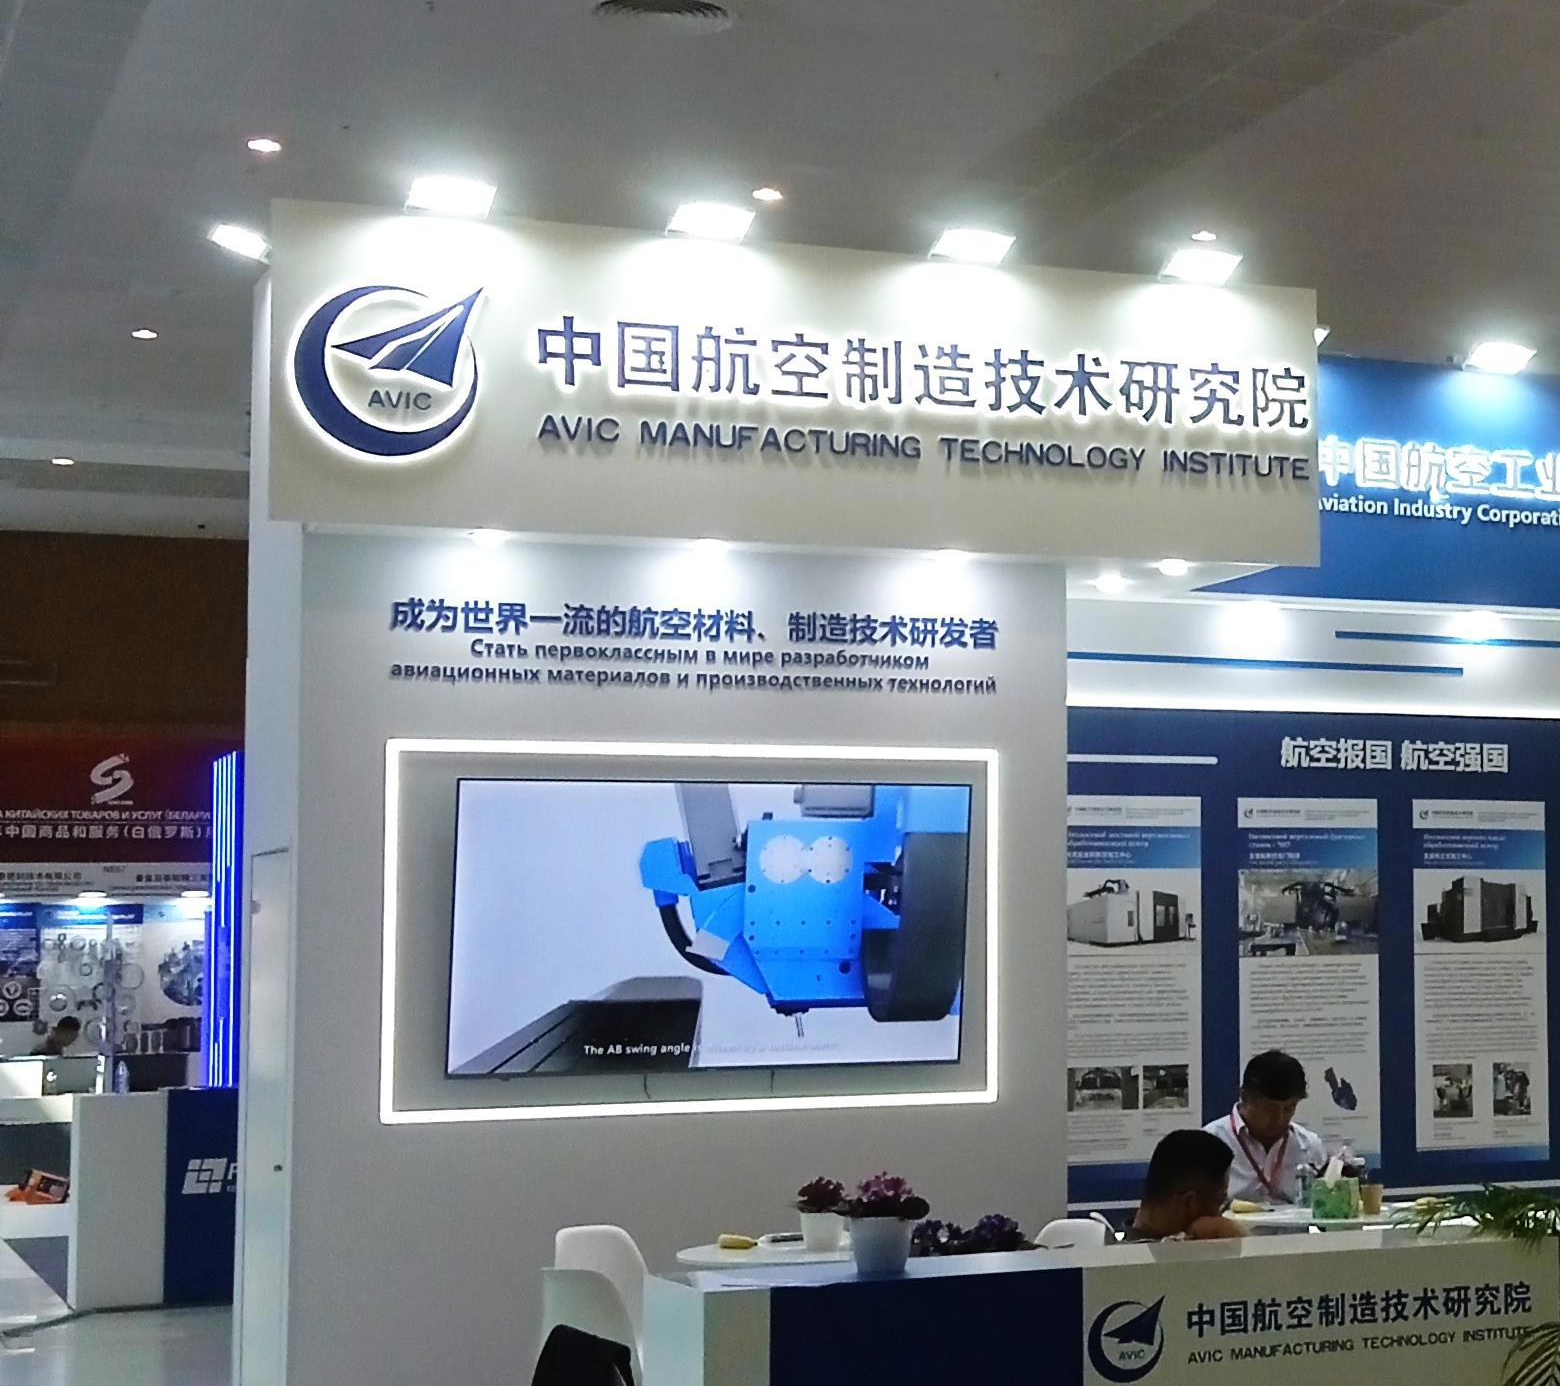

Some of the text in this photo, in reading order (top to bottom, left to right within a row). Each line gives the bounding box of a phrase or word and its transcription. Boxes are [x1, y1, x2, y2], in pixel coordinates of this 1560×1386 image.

[537, 315, 1309, 429] 中国航空制造技术研究院
[367, 389, 432, 411] AVIC
[537, 414, 1310, 481] AVIC MANUFACTURING TECHNOLOGY INSTITUTE
[1393, 498, 1473, 525] Industry
[470, 638, 930, 670] Стать первоклассным в мире разработчиком
[390, 662, 997, 695] авиационных материалов и производственных технологий
[1281, 736, 1509, 773] 航空报国 航空强国
[584, 1044, 604, 1056] The
[607, 1043, 623, 1056] AB
[625, 1043, 658, 1057] swing
[660, 1042, 691, 1056] angle
[1186, 1280, 1533, 1338] 中国航空制造技术研究院
[1118, 1349, 1146, 1361] AVIC
[1187, 1349, 1224, 1364] AVIC
[1230, 1338, 1354, 1361] MANUFACTURING
[1362, 1330, 1456, 1350] TECHNOLOGY
